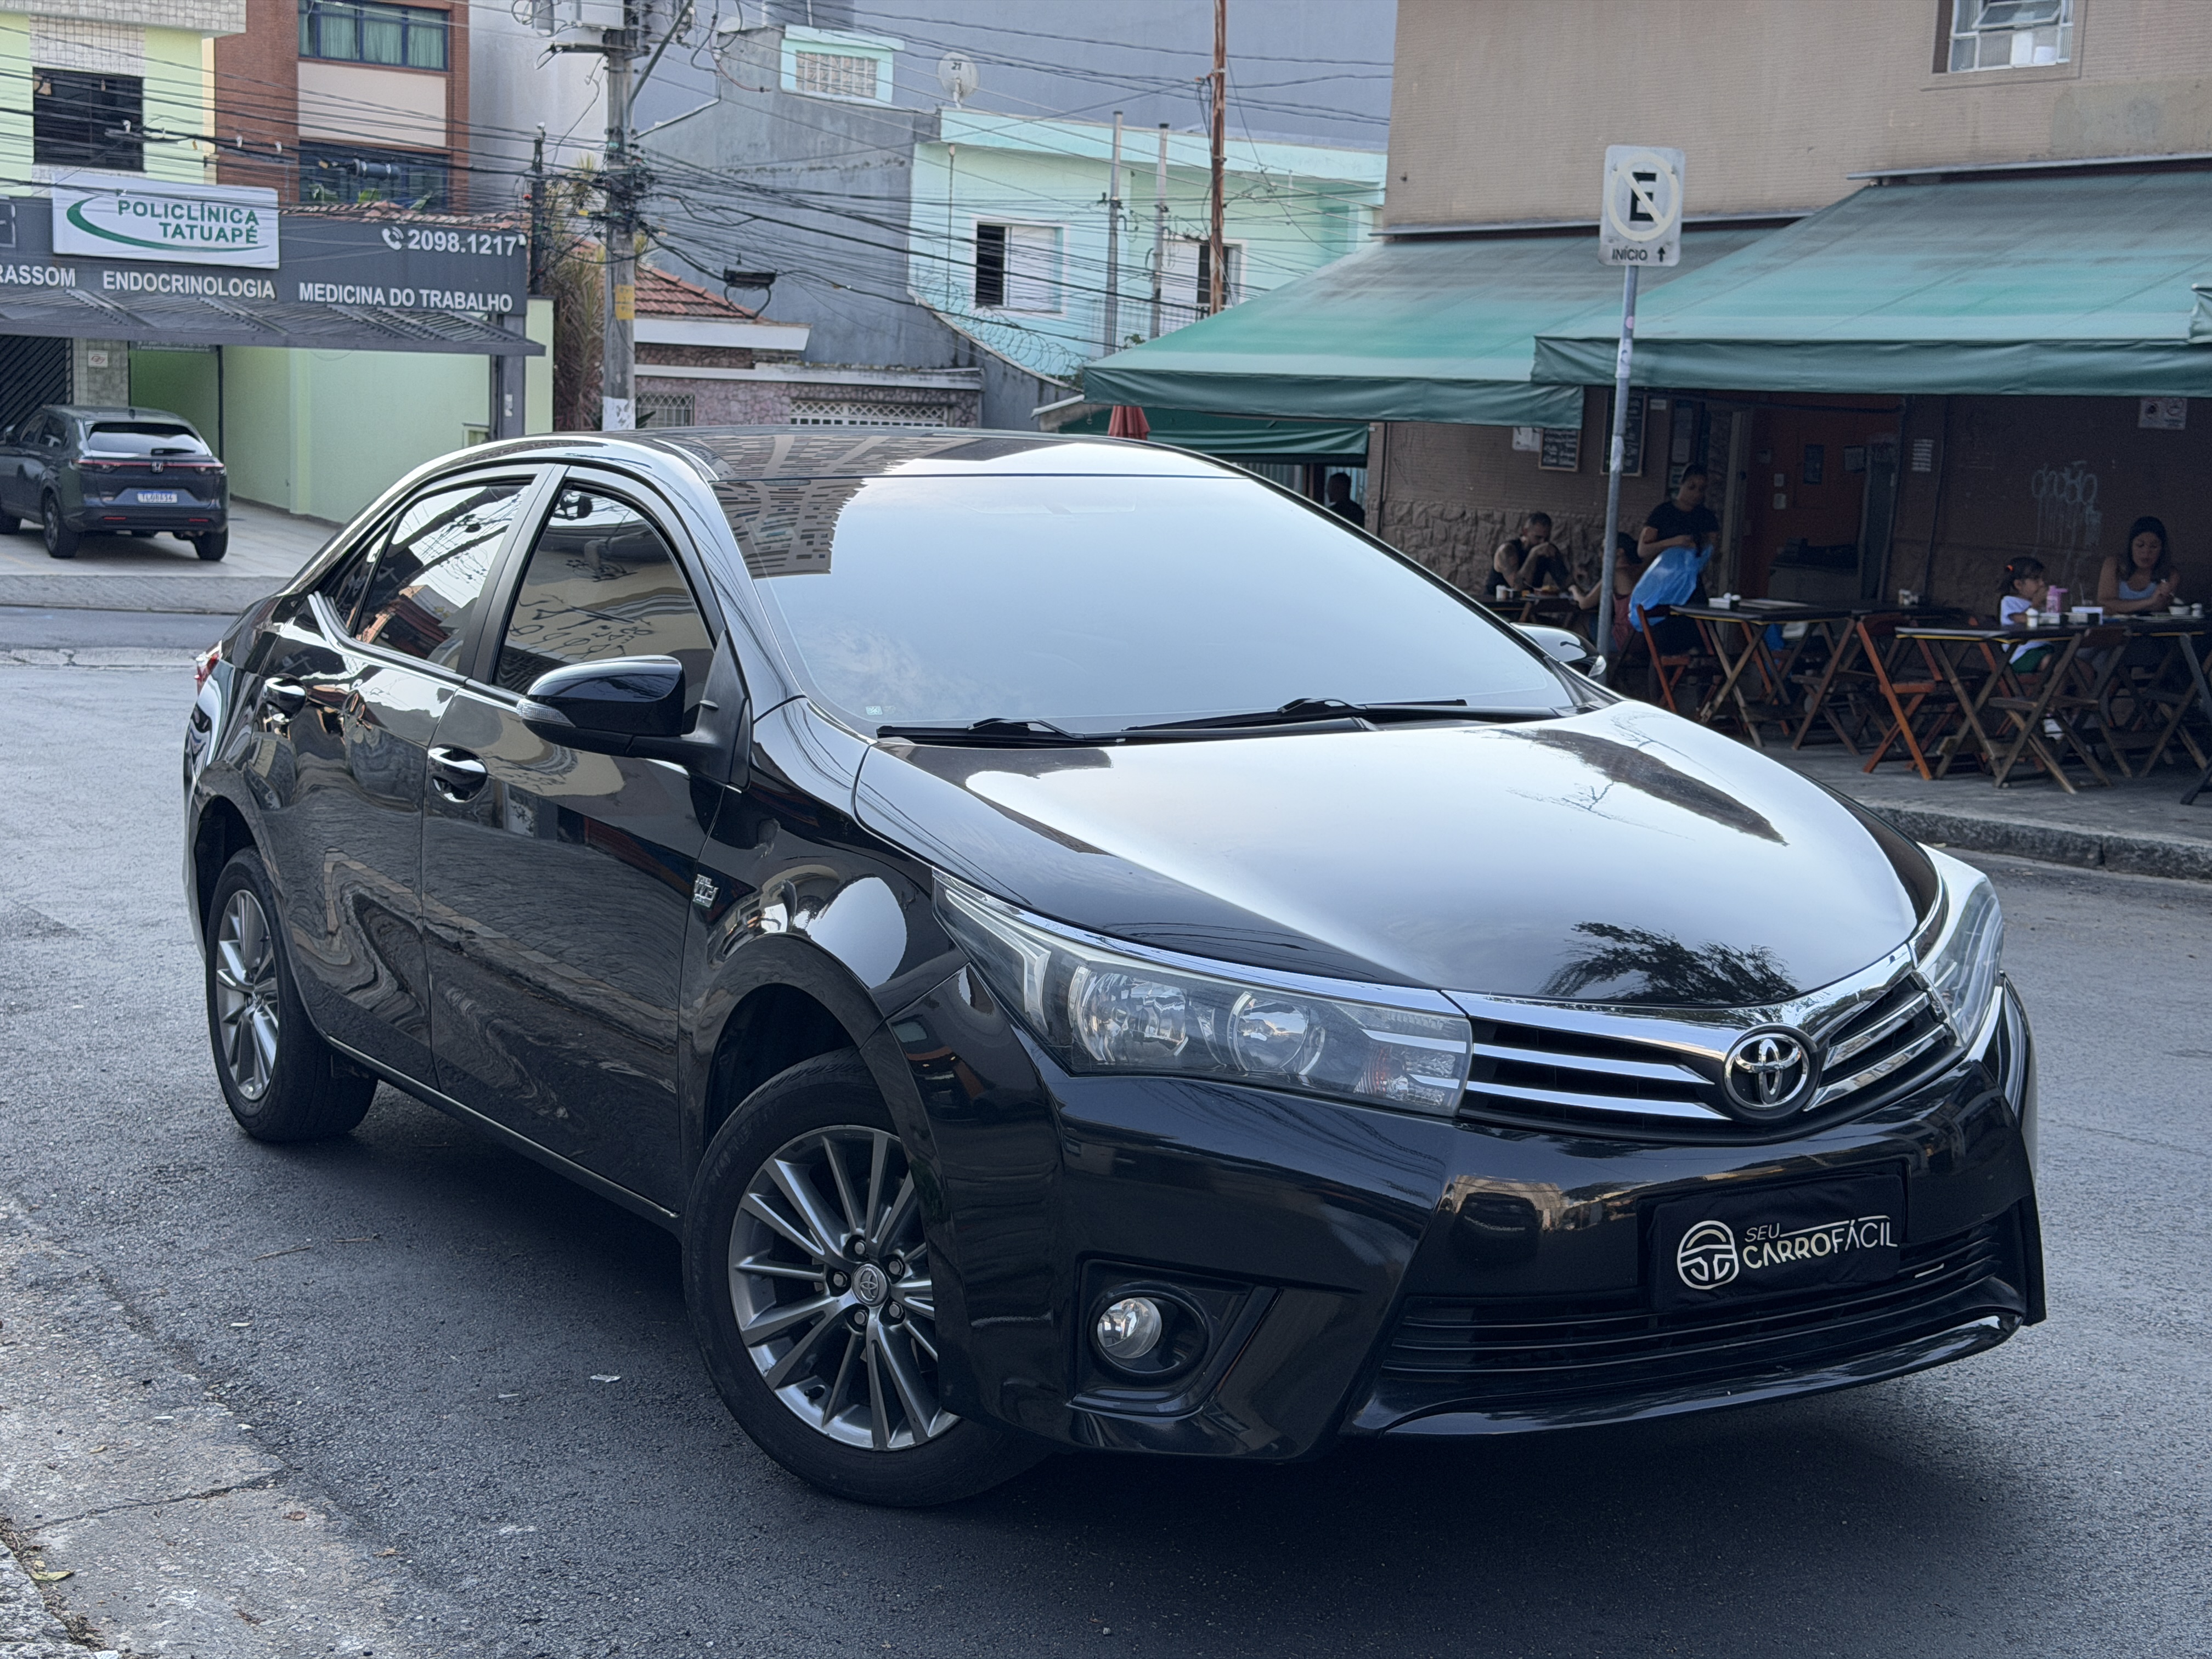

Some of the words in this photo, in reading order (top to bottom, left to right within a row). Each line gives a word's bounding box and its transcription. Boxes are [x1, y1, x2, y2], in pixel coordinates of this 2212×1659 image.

[1629, 171, 1657, 222] E
[118, 199, 259, 225] POLICLÍNICA
[159, 222, 258, 244] TATUAPÉ
[408, 229, 517, 256] 2098.1217
[1611, 245, 1649, 261] INÍCIO
[103, 270, 276, 299] ENDOCRINOLOGIA
[299, 282, 386, 306] MEDICINA
[389, 288, 415, 307] DO
[419, 289, 513, 313] TRABALHO
[1742, 1220, 1898, 1269] CARROFÁCIL
[1744, 1222, 1780, 1243] SEU
